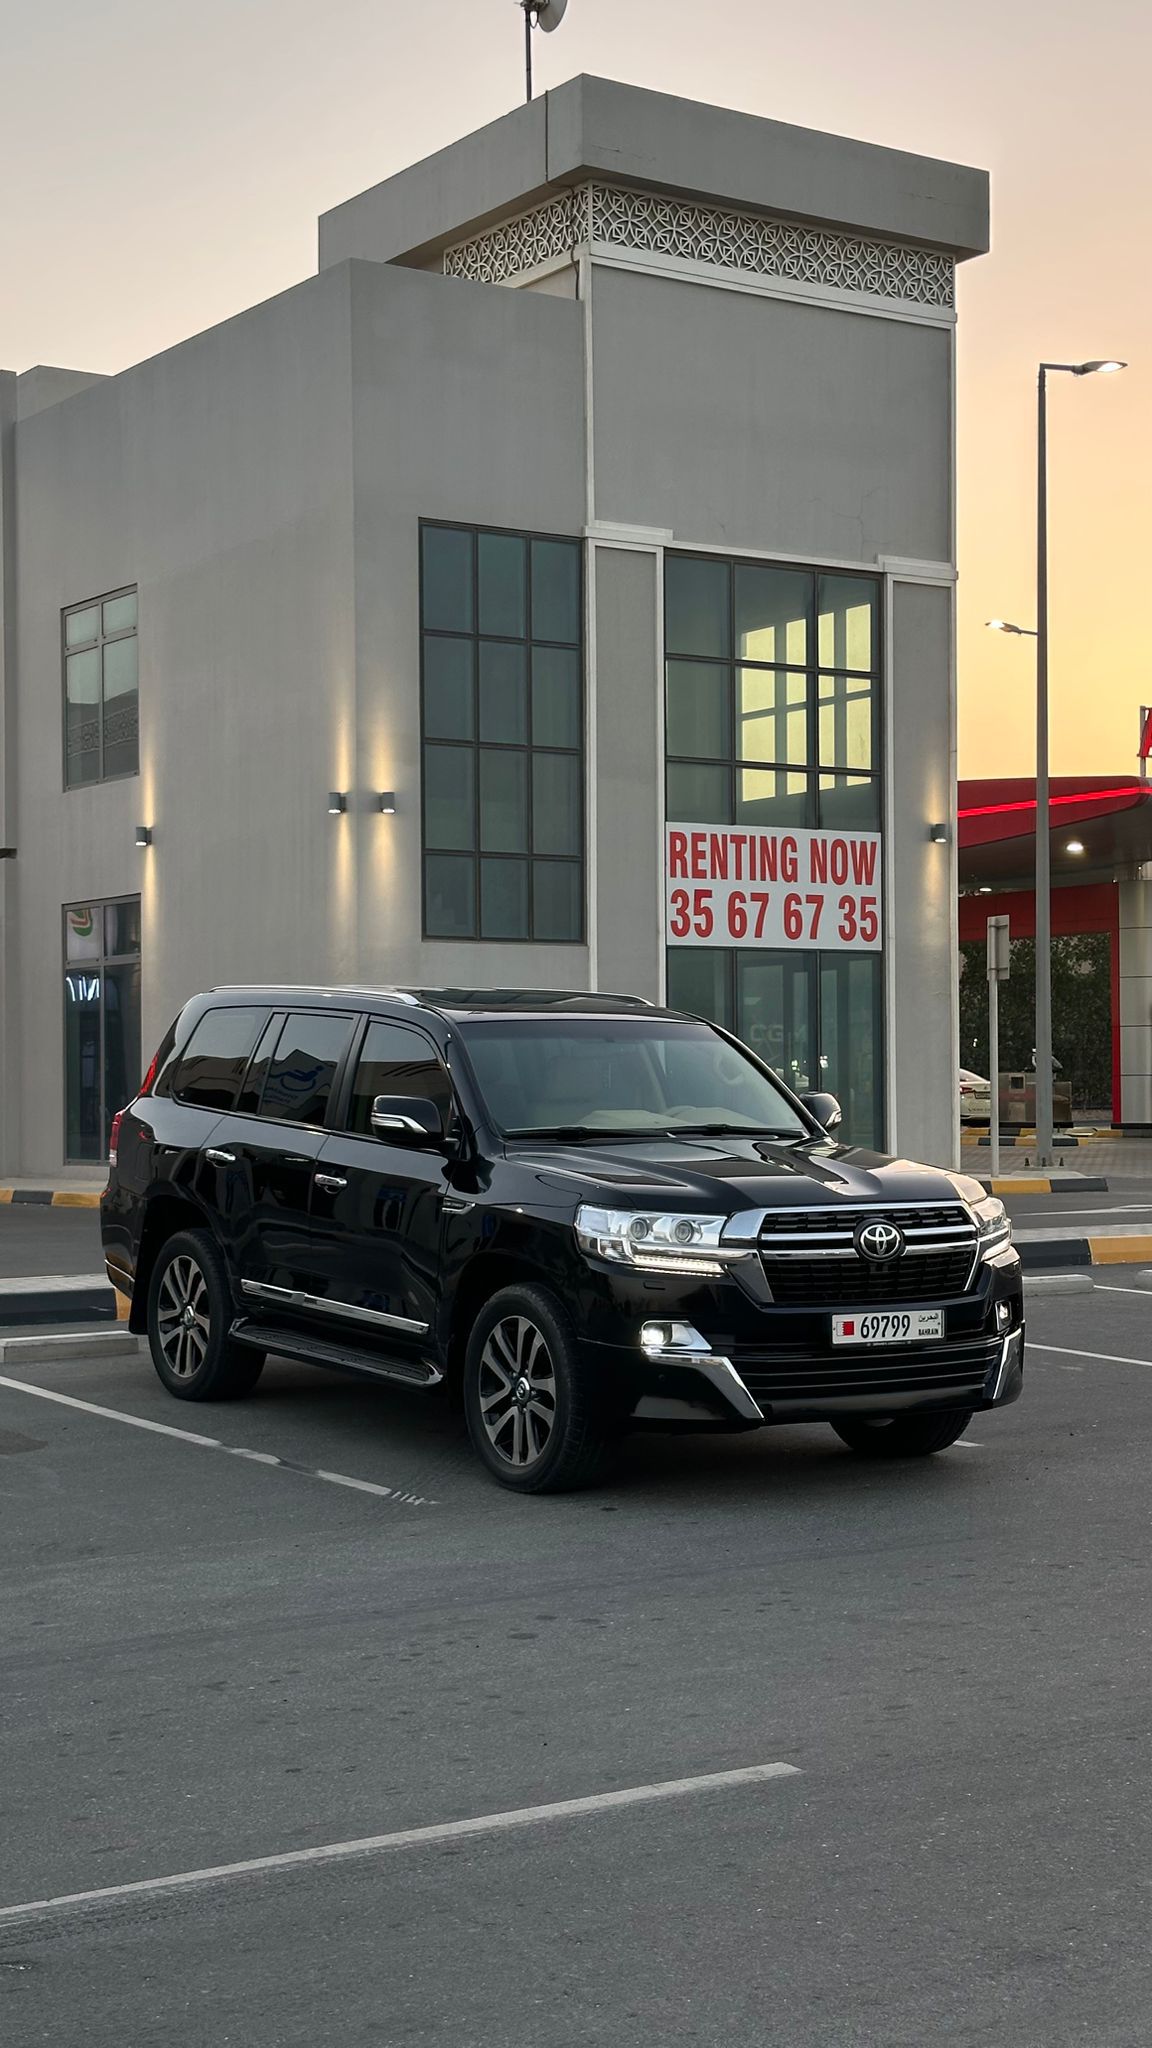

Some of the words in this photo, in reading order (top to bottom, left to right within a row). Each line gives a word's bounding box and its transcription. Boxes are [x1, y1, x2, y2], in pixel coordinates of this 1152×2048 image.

[669, 831, 798, 883] RENTING
[810, 838, 877, 886] NOW
[670, 889, 713, 938] 35
[727, 891, 769, 939] 67
[783, 893, 824, 940] 67
[838, 895, 878, 943] 35
[860, 1314, 911, 1339] 69799
[918, 1328, 939, 1336] BAHRAIN
